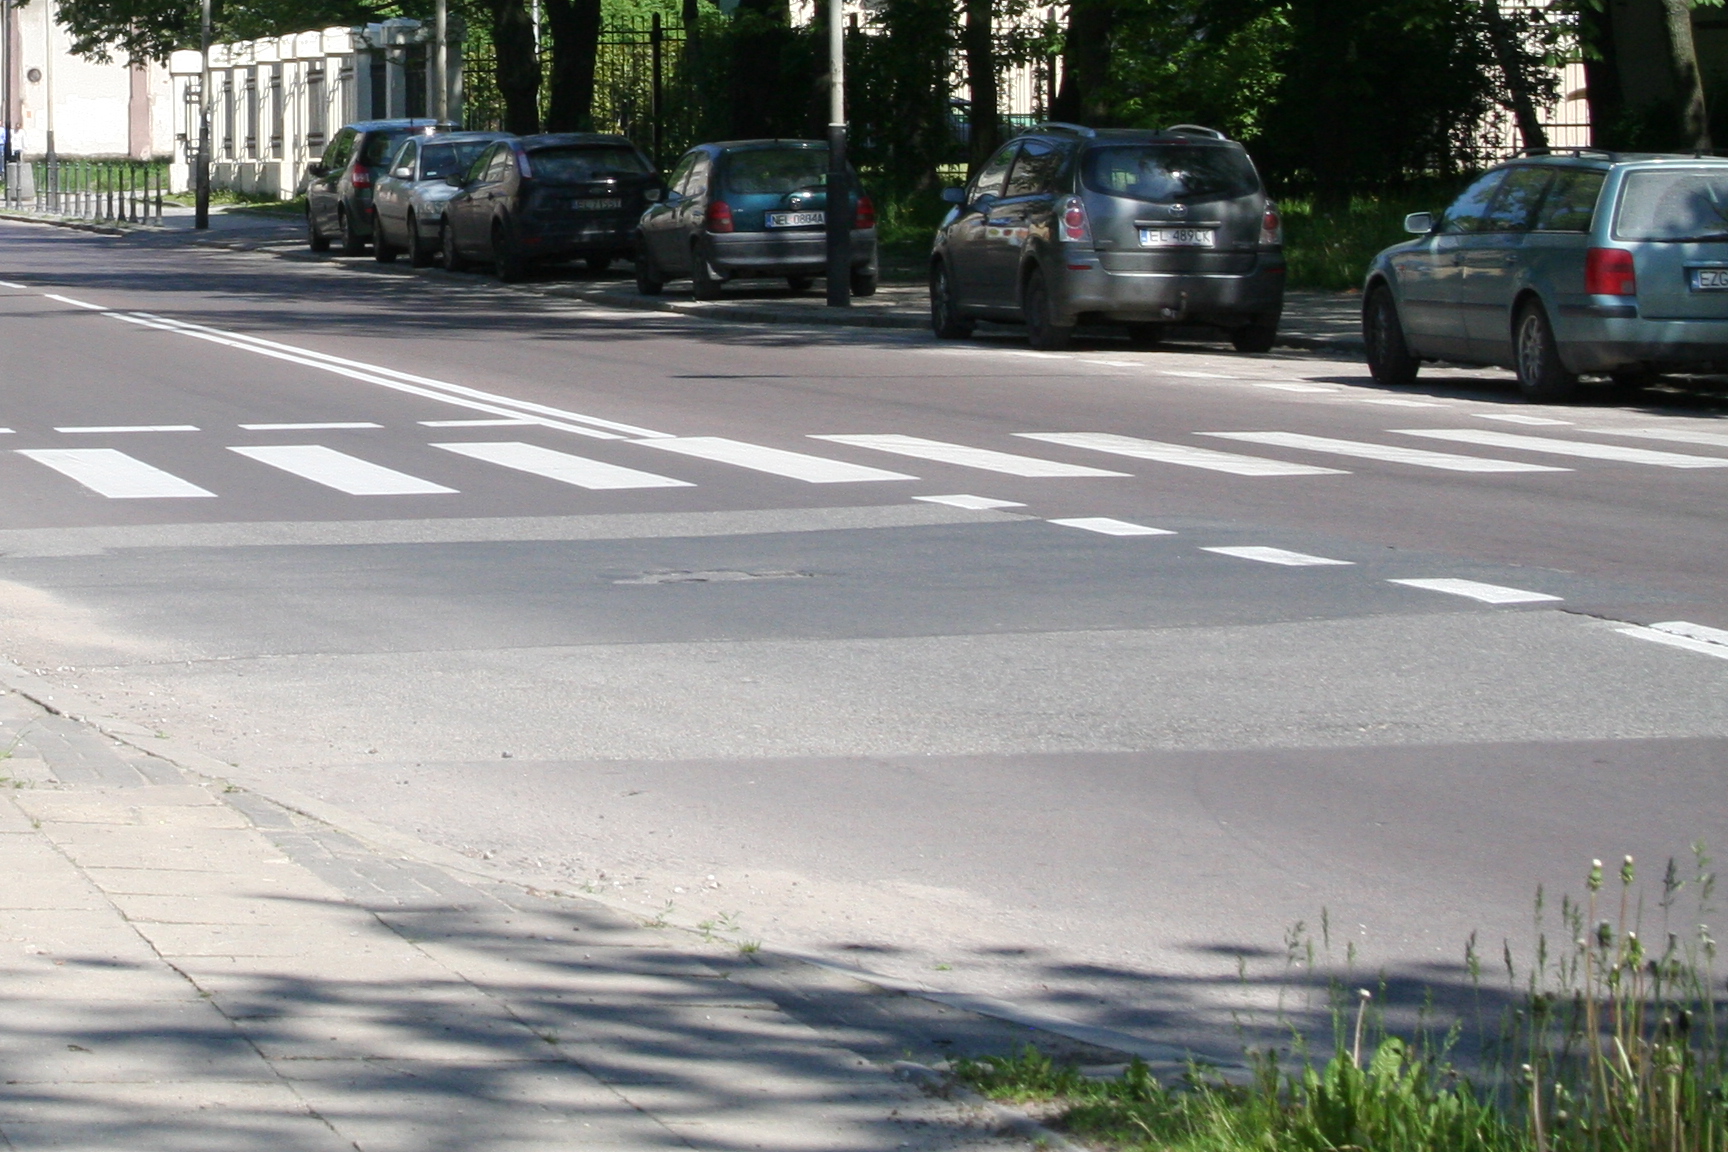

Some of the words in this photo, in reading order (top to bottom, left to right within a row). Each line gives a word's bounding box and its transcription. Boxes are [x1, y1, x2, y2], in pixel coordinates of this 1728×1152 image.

[772, 214, 790, 225] NEL
[1149, 229, 1168, 242] EL
[1172, 228, 1211, 243] 489CK
